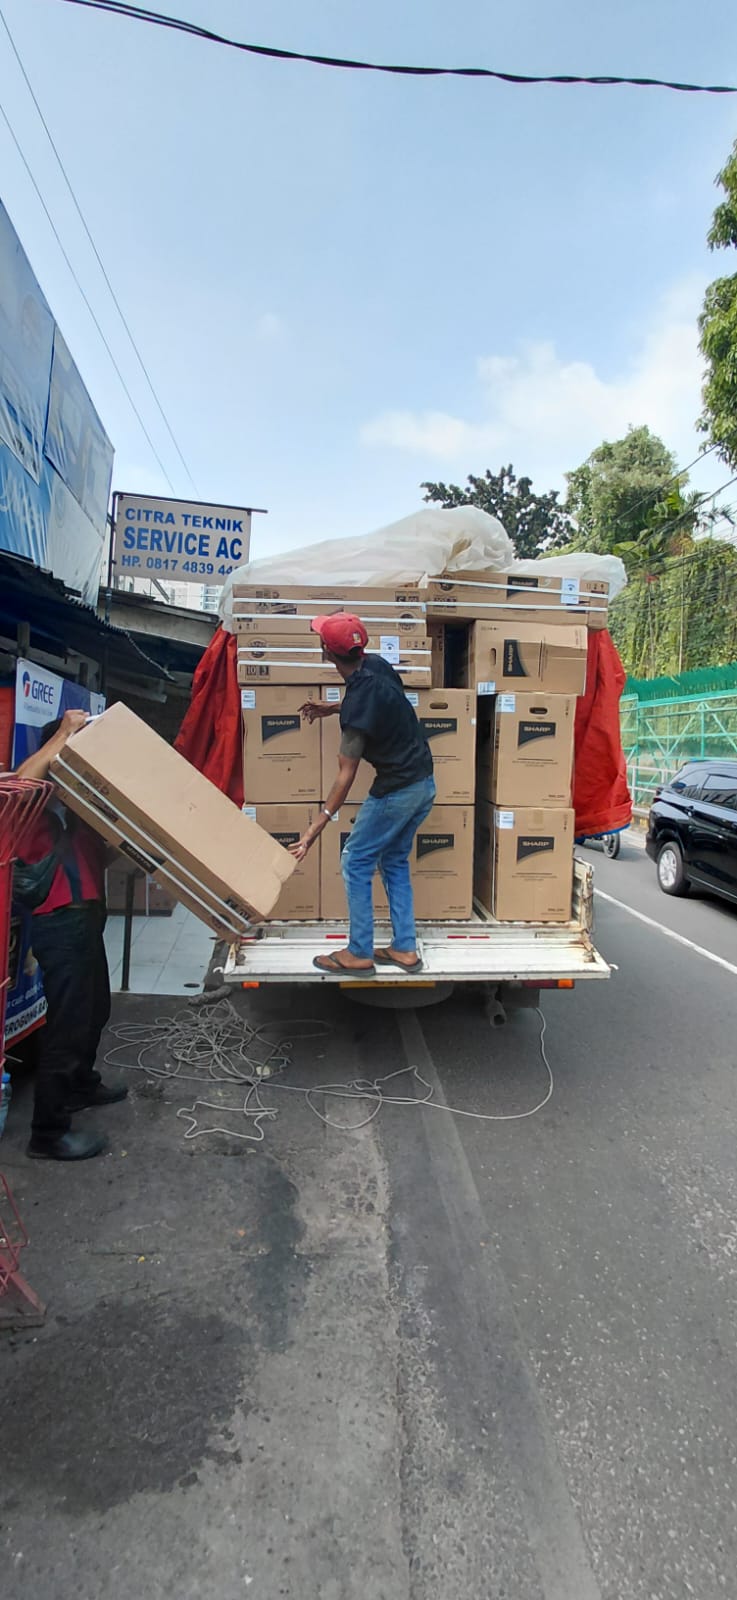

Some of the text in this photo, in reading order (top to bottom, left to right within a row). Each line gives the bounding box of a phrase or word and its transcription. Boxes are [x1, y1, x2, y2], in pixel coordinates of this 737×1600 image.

[125, 508, 243, 533] CITRA TEKNIK
[123, 526, 243, 560] SERVICE AC
[121, 555, 141, 568] HP.
[146, 557, 178, 571] 0817
[182, 560, 214, 574] 4839
[31, 680, 55, 705] GREE
[266, 719, 296, 727] SHARP
